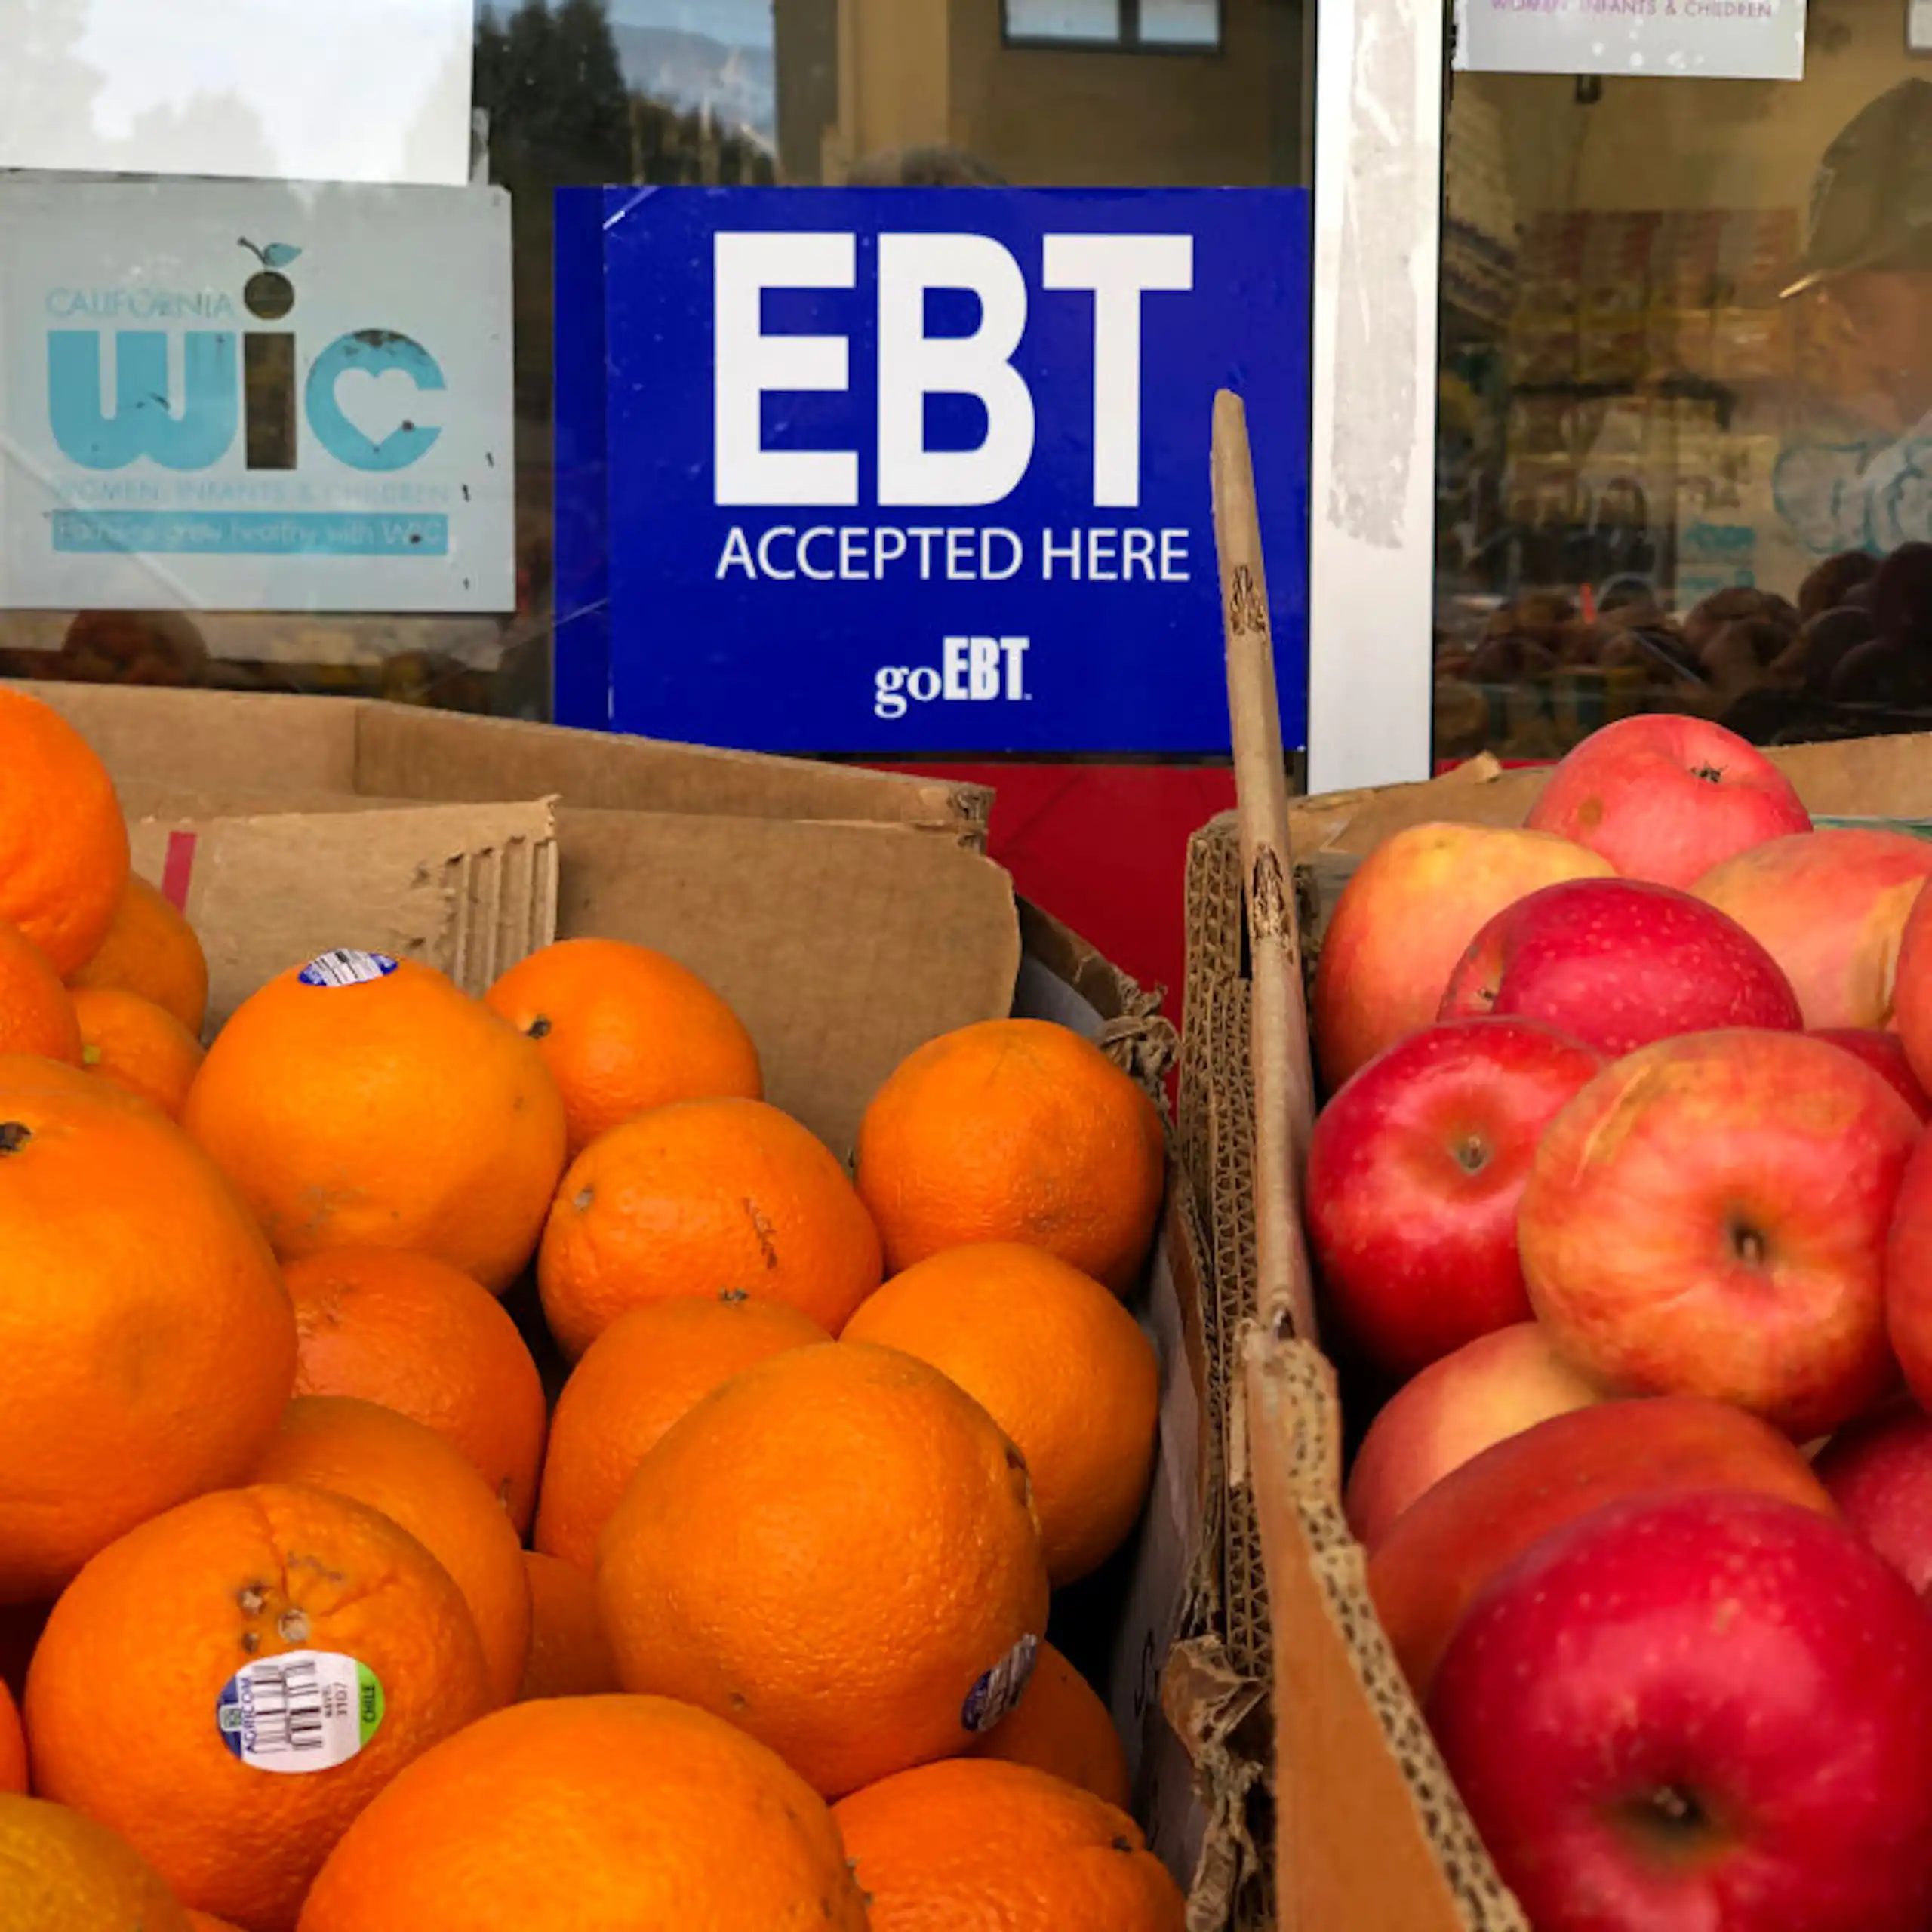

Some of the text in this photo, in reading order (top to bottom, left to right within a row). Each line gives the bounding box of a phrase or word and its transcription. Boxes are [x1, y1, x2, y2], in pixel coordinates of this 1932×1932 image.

[1684, 2, 1772, 17] CHILDREN
[45, 286, 235, 320] CALIFORNIA
[714, 232, 1193, 508] EBT
[715, 526, 1189, 581] ACCEPTED HERE
[241, 1677, 258, 1755] AGRICOM
[333, 1681, 348, 1717] 3107
[361, 1684, 377, 1724] CHILE
